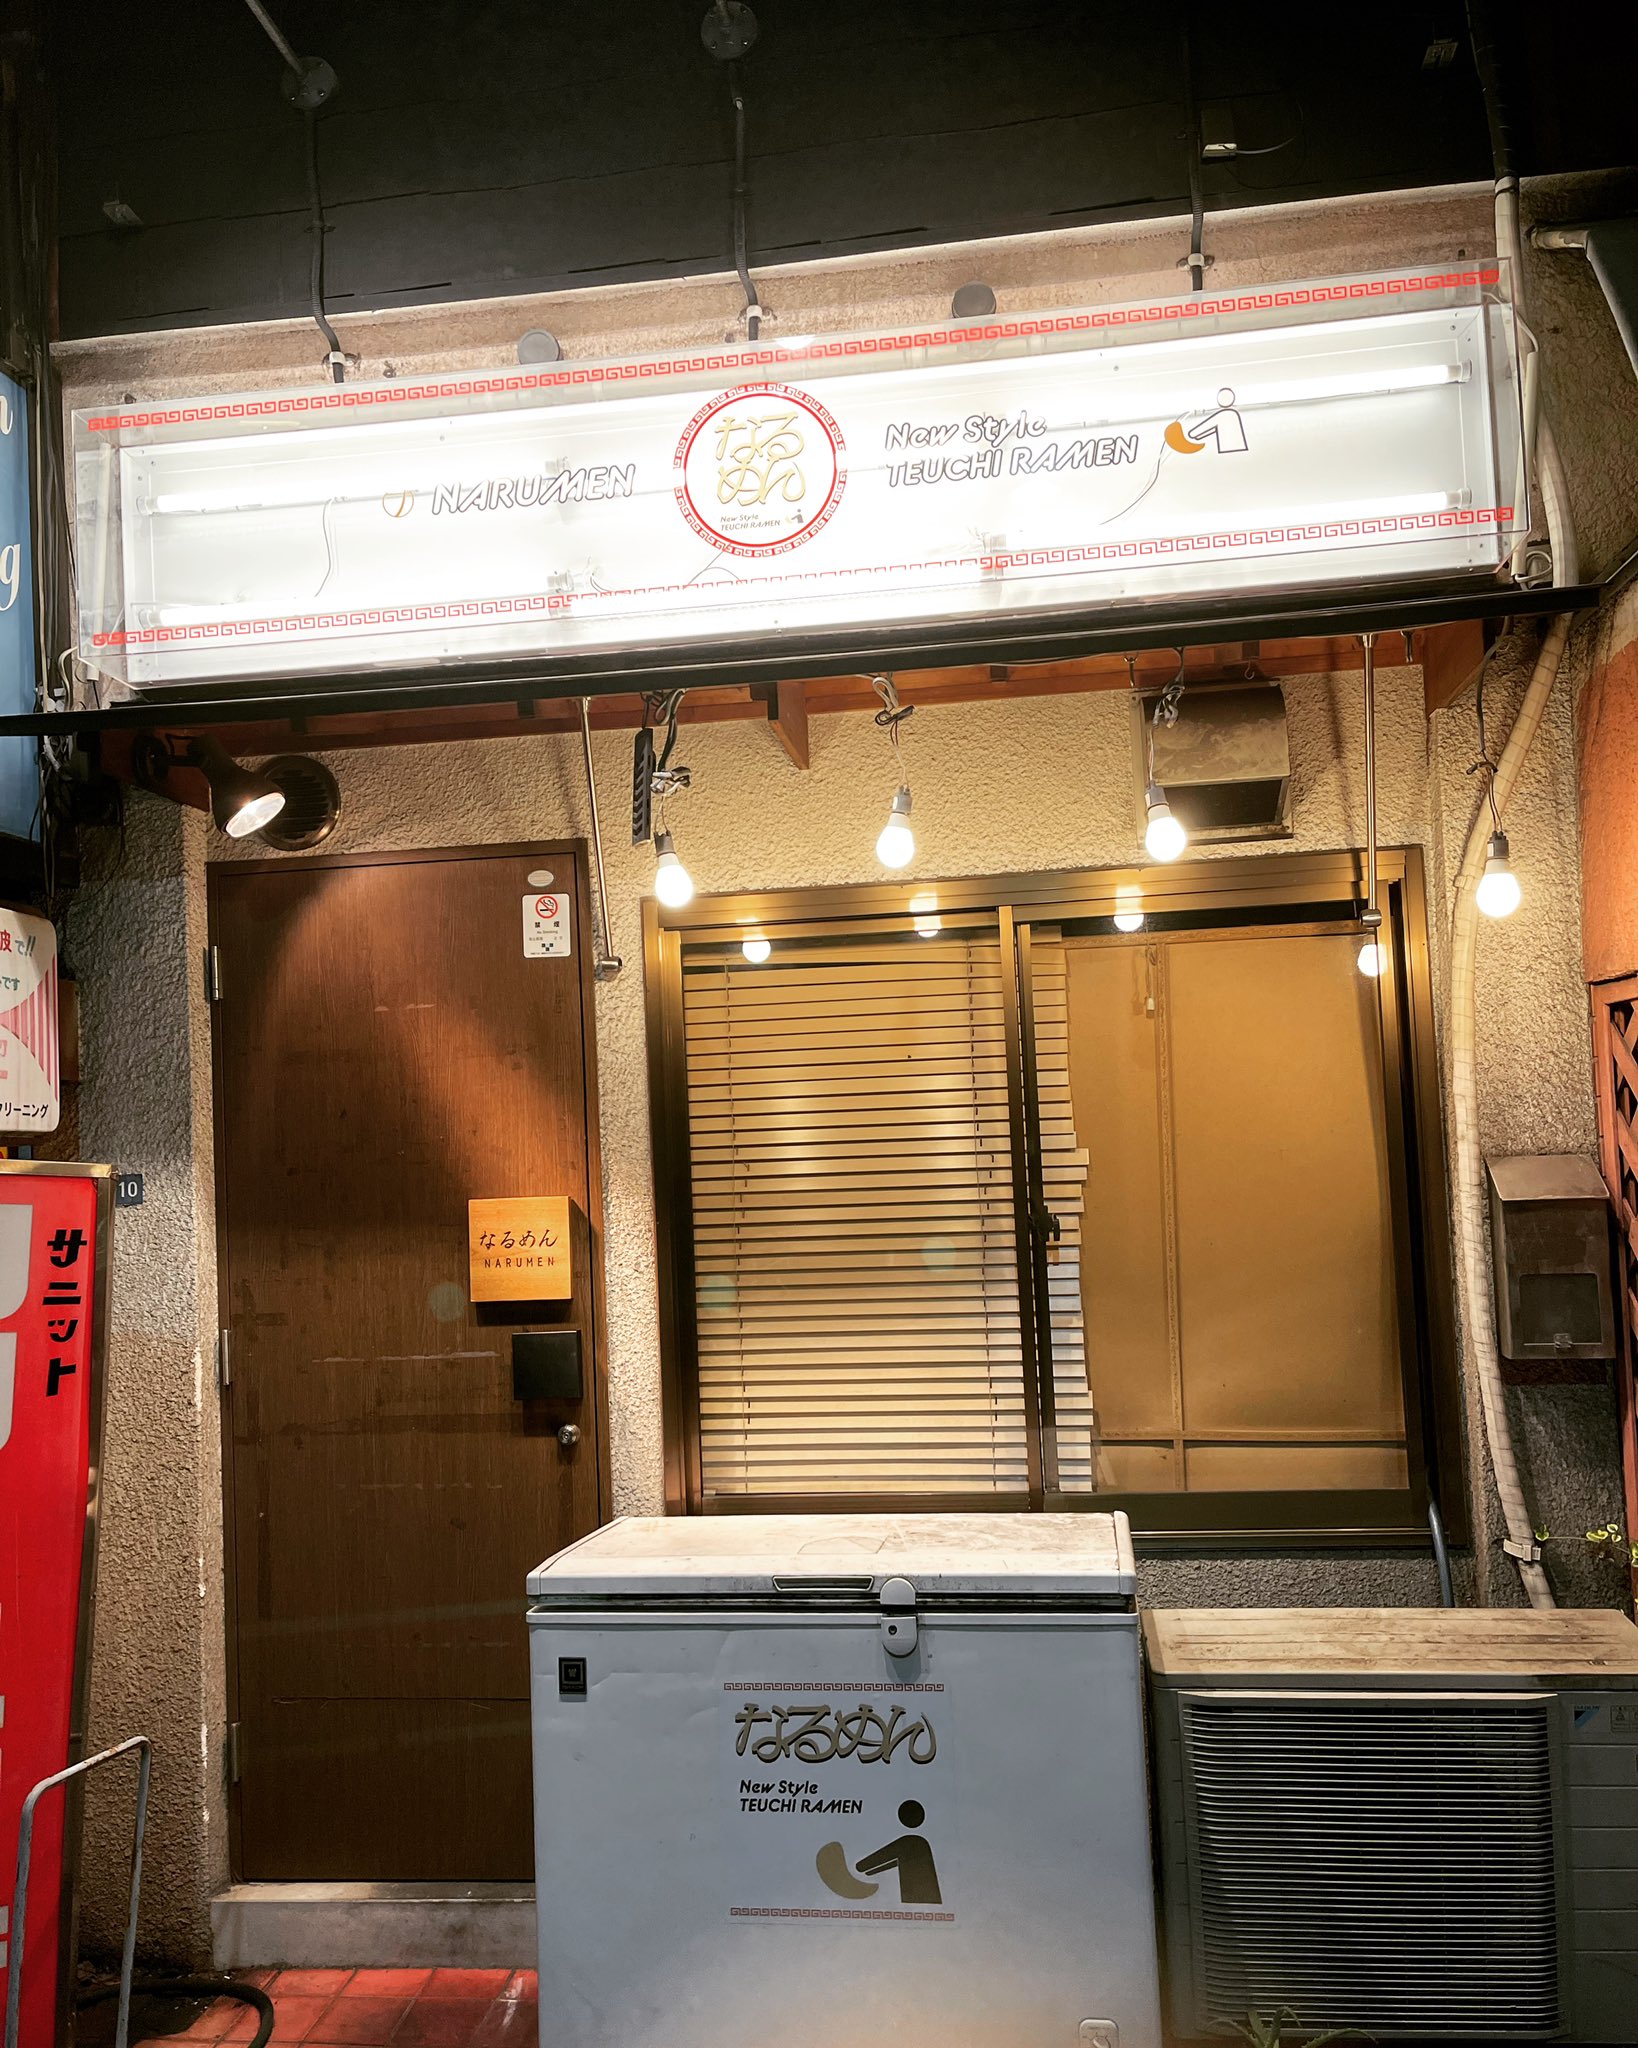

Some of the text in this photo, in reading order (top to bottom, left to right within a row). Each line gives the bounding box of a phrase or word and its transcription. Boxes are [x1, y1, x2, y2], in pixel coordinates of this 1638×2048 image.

[885, 410, 1047, 450] New Style
[887, 435, 1138, 487] TEUCHI RAMEN
[432, 464, 636, 515] NARUMEN
[721, 520, 780, 531] TEUCHI RAMEN
[740, 513, 759, 522] Style
[118, 1181, 138, 1198] 10
[480, 1229, 558, 1250] なるめん
[484, 1257, 555, 1268] NARUMEN
[42, 1229, 87, 1397] サニット
[735, 1703, 937, 1764] なるめん
[740, 1780, 818, 1797] New Style
[740, 1799, 863, 1814] TEUCHI RAMEN
